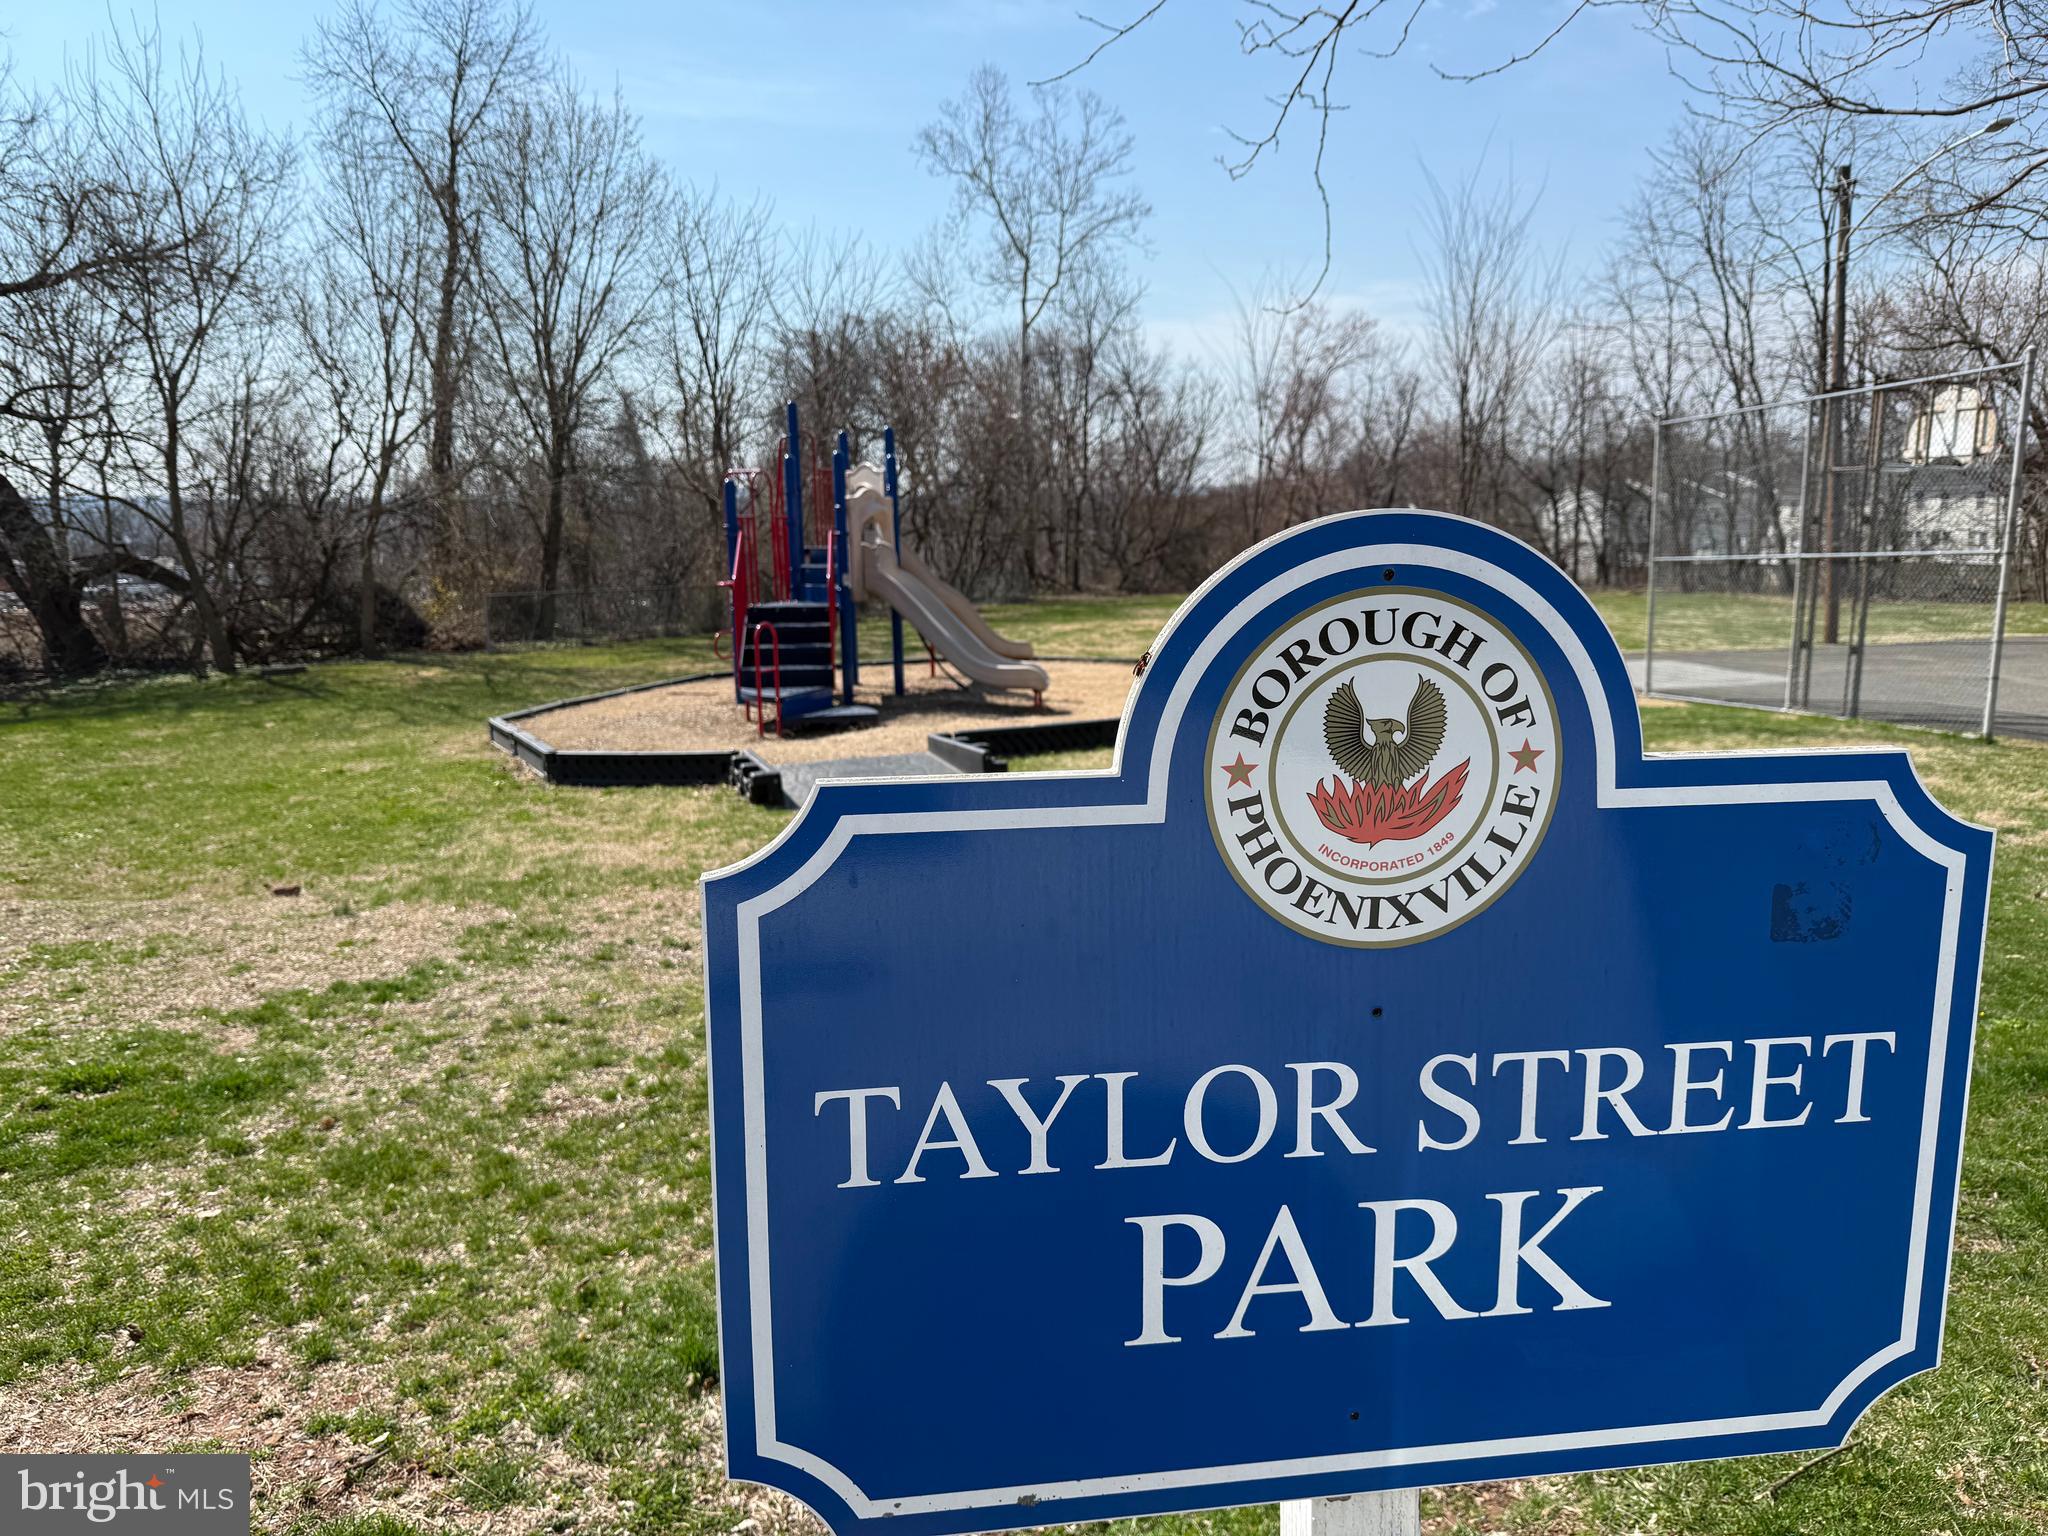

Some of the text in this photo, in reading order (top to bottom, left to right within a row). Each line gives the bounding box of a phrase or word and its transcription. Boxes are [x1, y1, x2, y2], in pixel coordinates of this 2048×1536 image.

[1229, 608, 1537, 748] BOROUGH OF
[1227, 783, 1541, 930] PHOENIXVILLE
[1318, 831, 1455, 872] INCORPORATED 1849
[815, 1031, 1896, 1189] TAYLOR STREET
[1124, 1186, 1612, 1347] PARK
